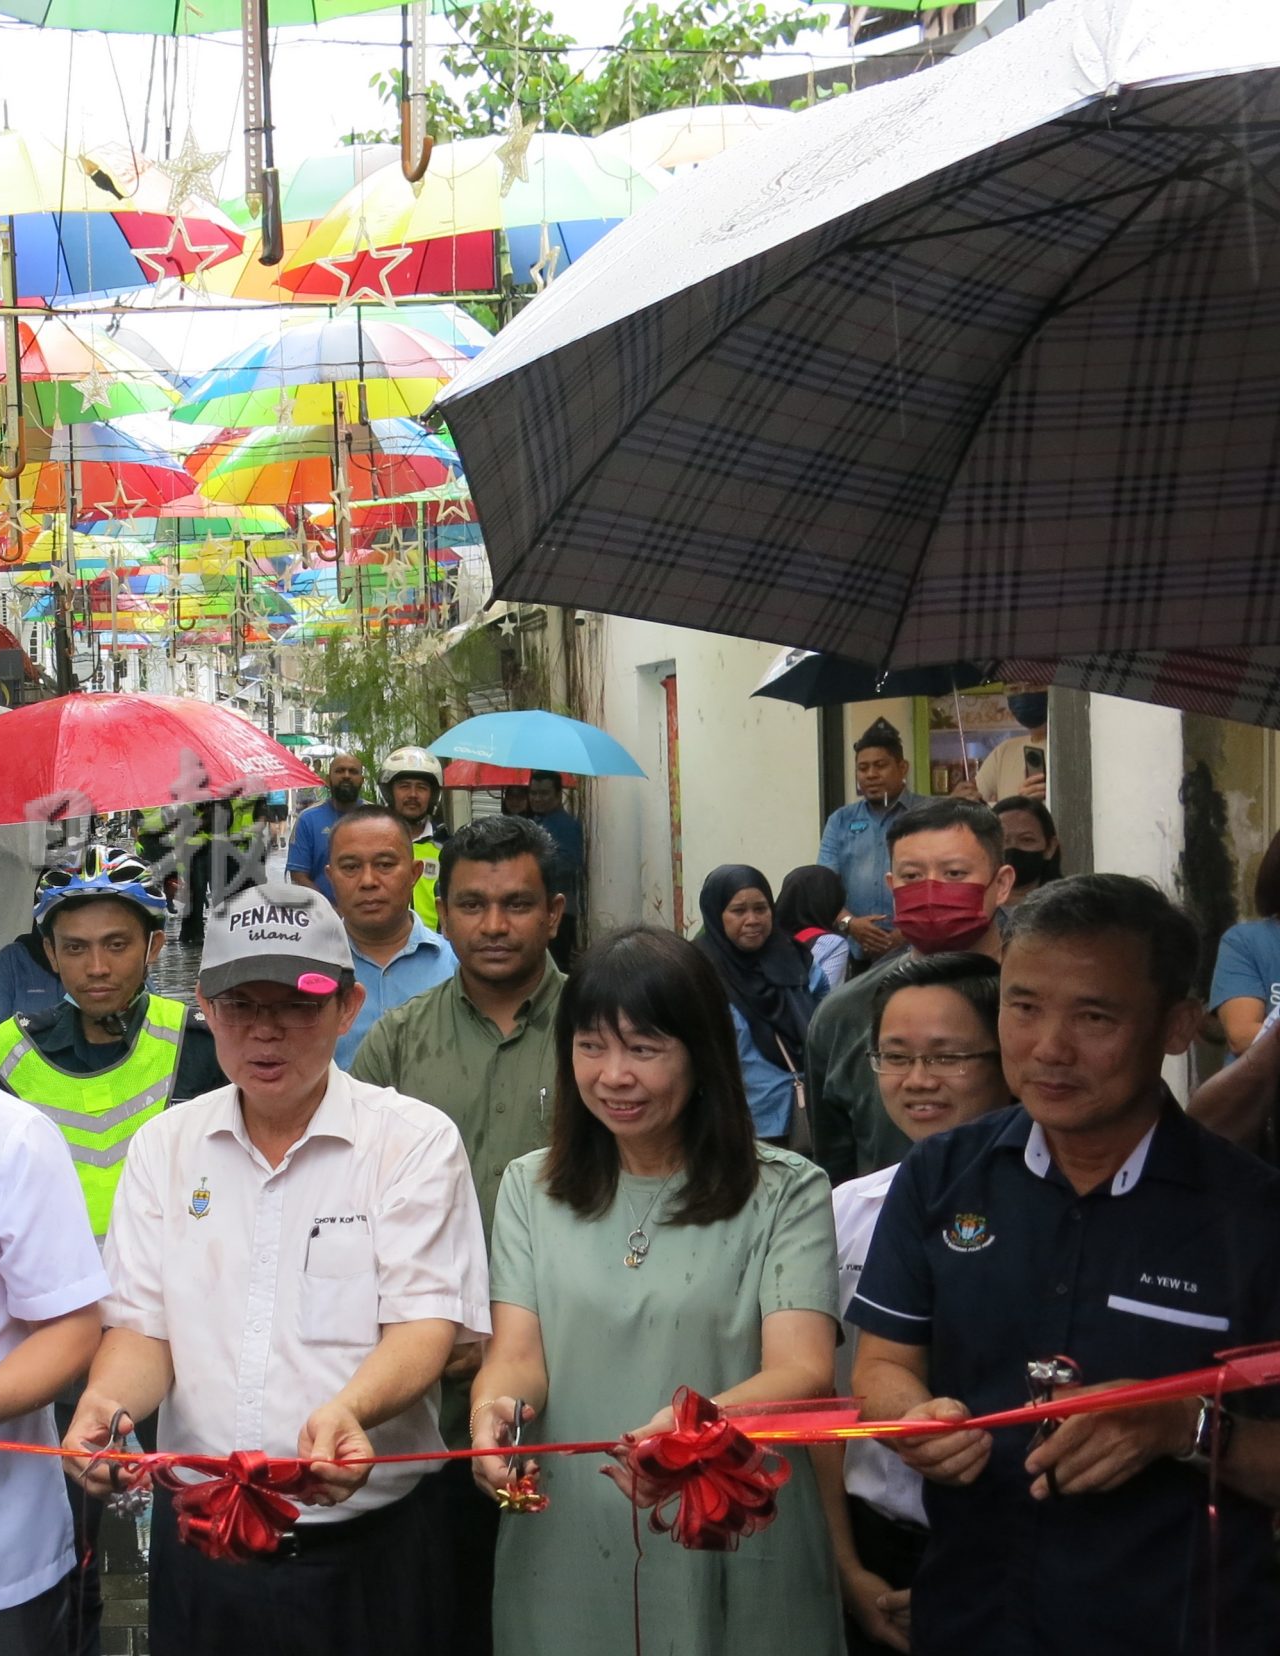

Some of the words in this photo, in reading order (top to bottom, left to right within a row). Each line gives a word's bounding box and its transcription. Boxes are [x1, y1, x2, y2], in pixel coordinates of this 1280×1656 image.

[229, 904, 310, 932] PENANG
[248, 929, 301, 942] island
[314, 1217, 336, 1225] CHOW
[1156, 1275, 1181, 1290] YEW
